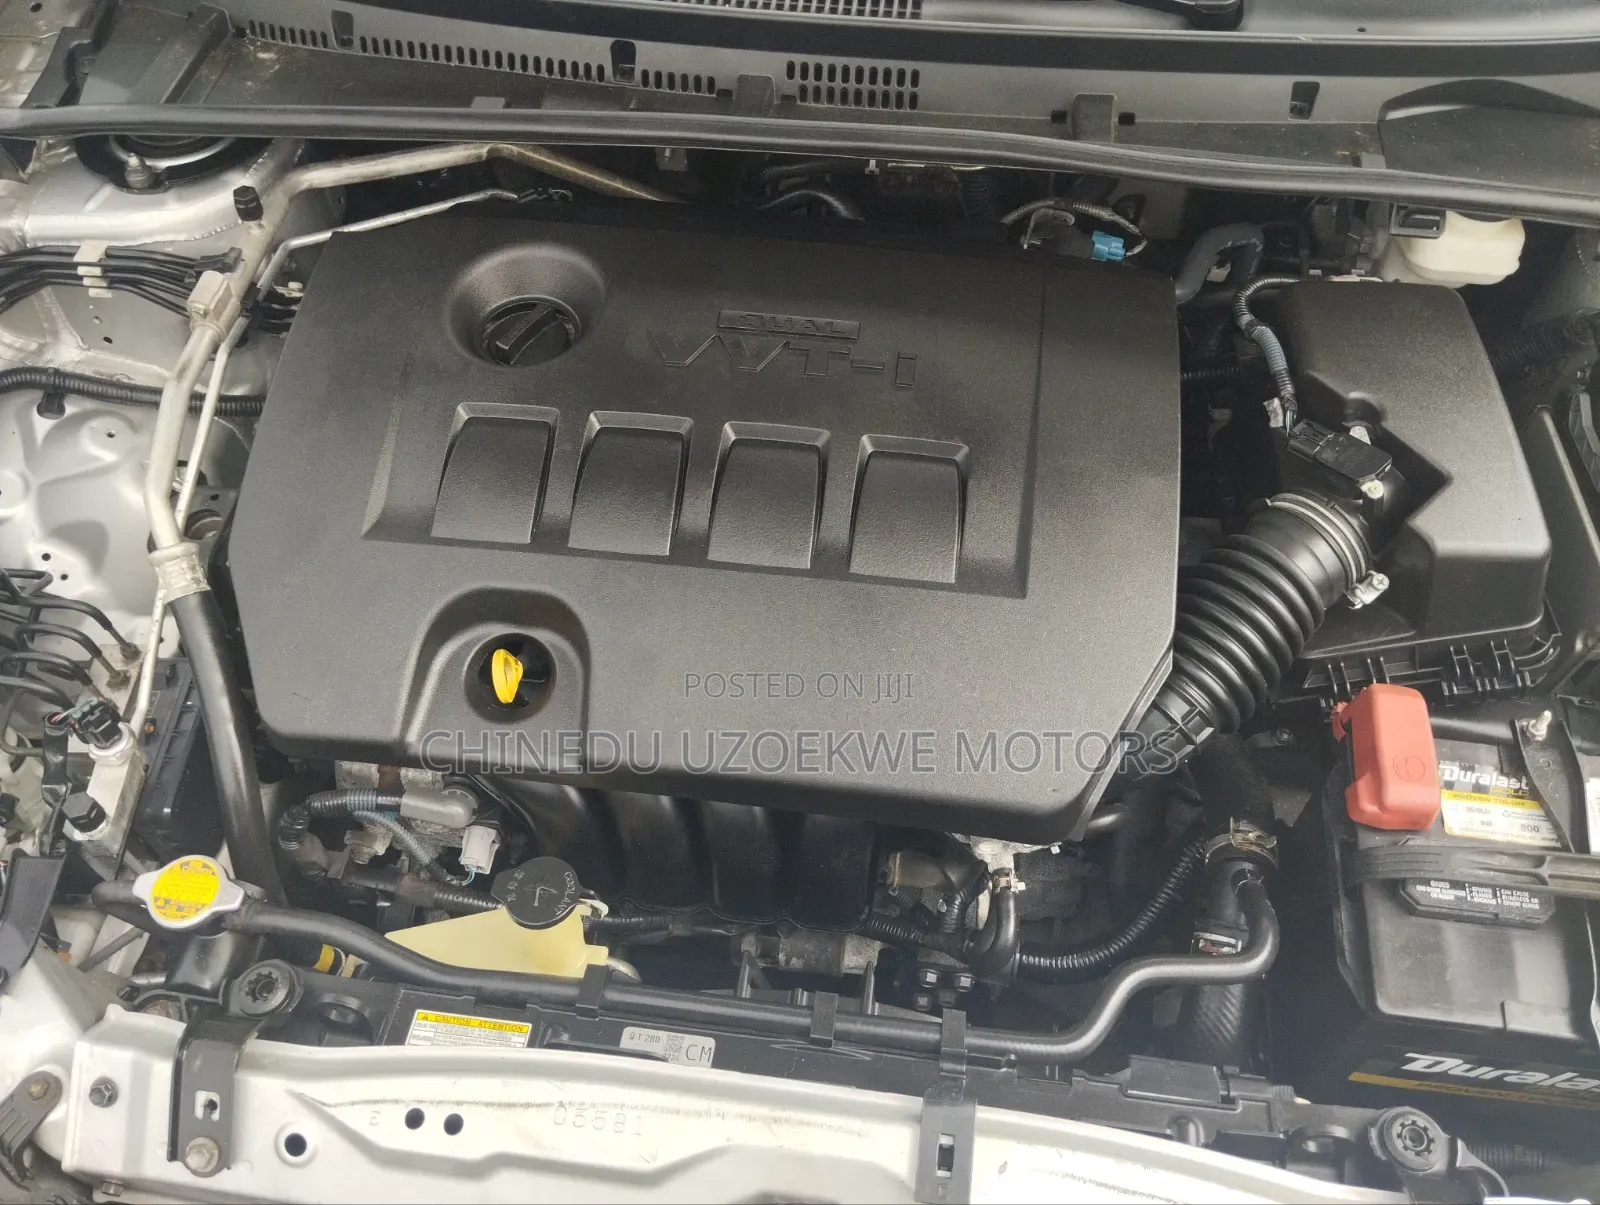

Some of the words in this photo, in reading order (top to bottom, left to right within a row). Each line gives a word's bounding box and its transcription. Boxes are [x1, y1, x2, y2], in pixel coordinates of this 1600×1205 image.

[1438, 762, 1530, 790] Duralast
[1520, 823, 1540, 833] 800
[554, 871, 576, 916] COOLANT
[434, 1015, 472, 1027] CAUTION
[478, 1020, 524, 1033] ATTENTION
[685, 1043, 713, 1063] CM
